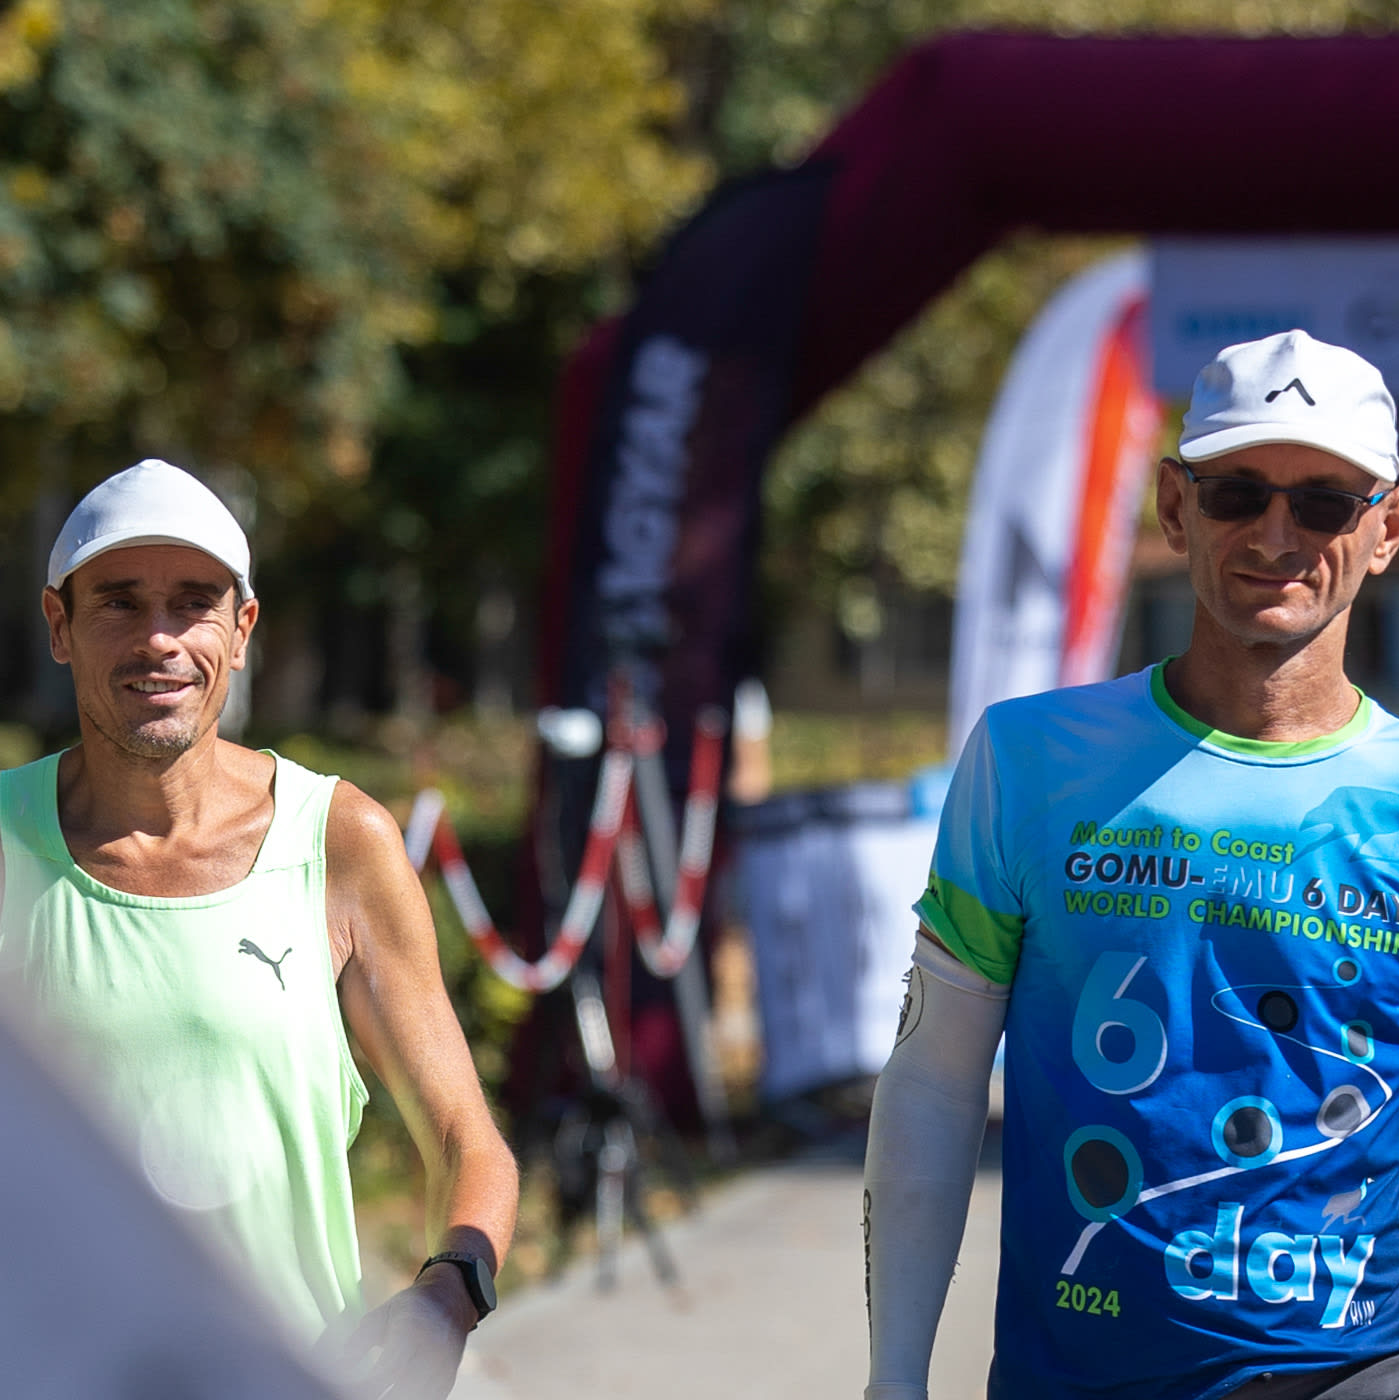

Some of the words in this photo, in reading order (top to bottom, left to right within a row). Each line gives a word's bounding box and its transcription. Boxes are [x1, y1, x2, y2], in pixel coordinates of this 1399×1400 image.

[1070, 821, 1163, 848] Mount
[1172, 827, 1200, 851] to
[1211, 830, 1294, 865] Coast
[1063, 890, 1170, 920] WORLD
[1303, 878, 1327, 910] 6
[1072, 952, 1168, 1095] 6
[1164, 1201, 1376, 1328] day
[1055, 1280, 1121, 1318] 2024
